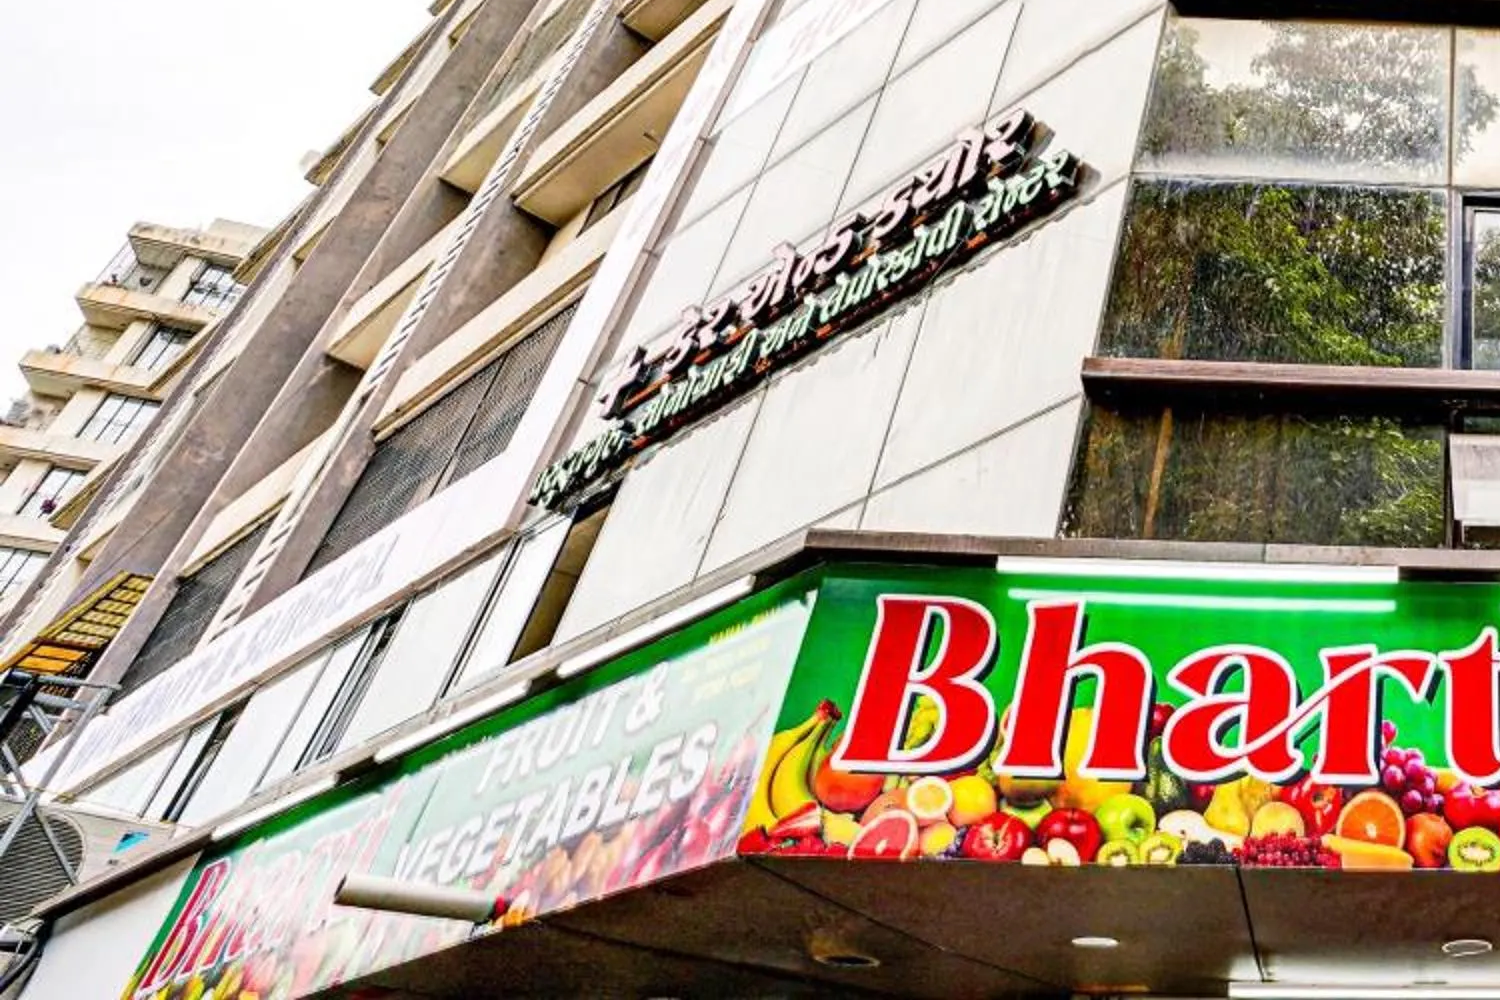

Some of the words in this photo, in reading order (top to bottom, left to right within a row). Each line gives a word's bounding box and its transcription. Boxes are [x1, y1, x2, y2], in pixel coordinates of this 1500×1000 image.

[476, 682, 635, 796] FRUIT
[622, 659, 672, 734] &
[393, 721, 719, 888] VEGETABLES
